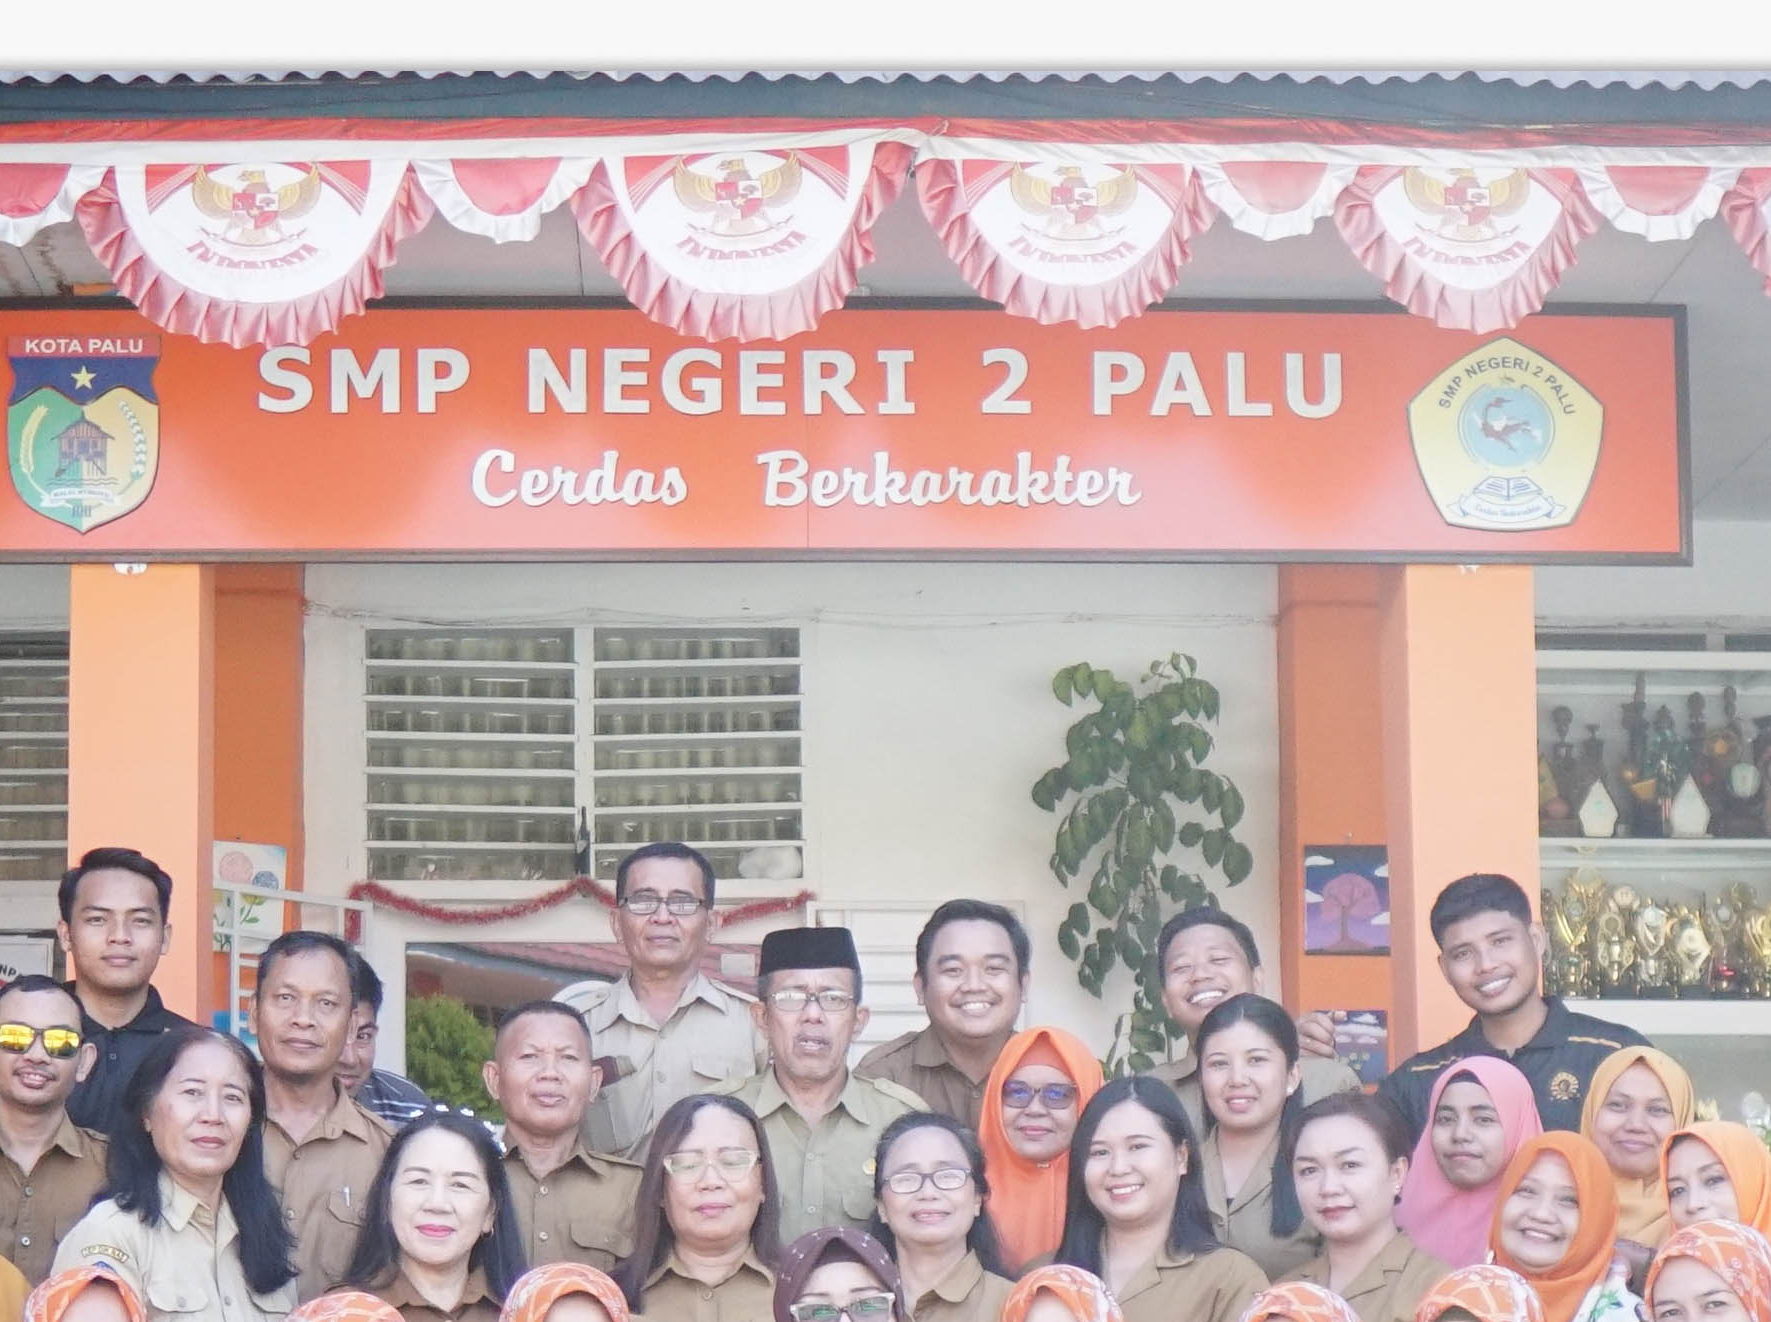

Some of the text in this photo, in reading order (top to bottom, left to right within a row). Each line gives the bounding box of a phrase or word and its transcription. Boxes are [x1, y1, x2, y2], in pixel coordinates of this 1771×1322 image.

[25, 338, 144, 354] KOTA PALU
[257, 346, 1344, 420] SMP NEGERI 2 PALU
[1438, 356, 1577, 415] SMP NEGERI 2 PALU
[471, 448, 1143, 509] Cerdas Berkarakter
